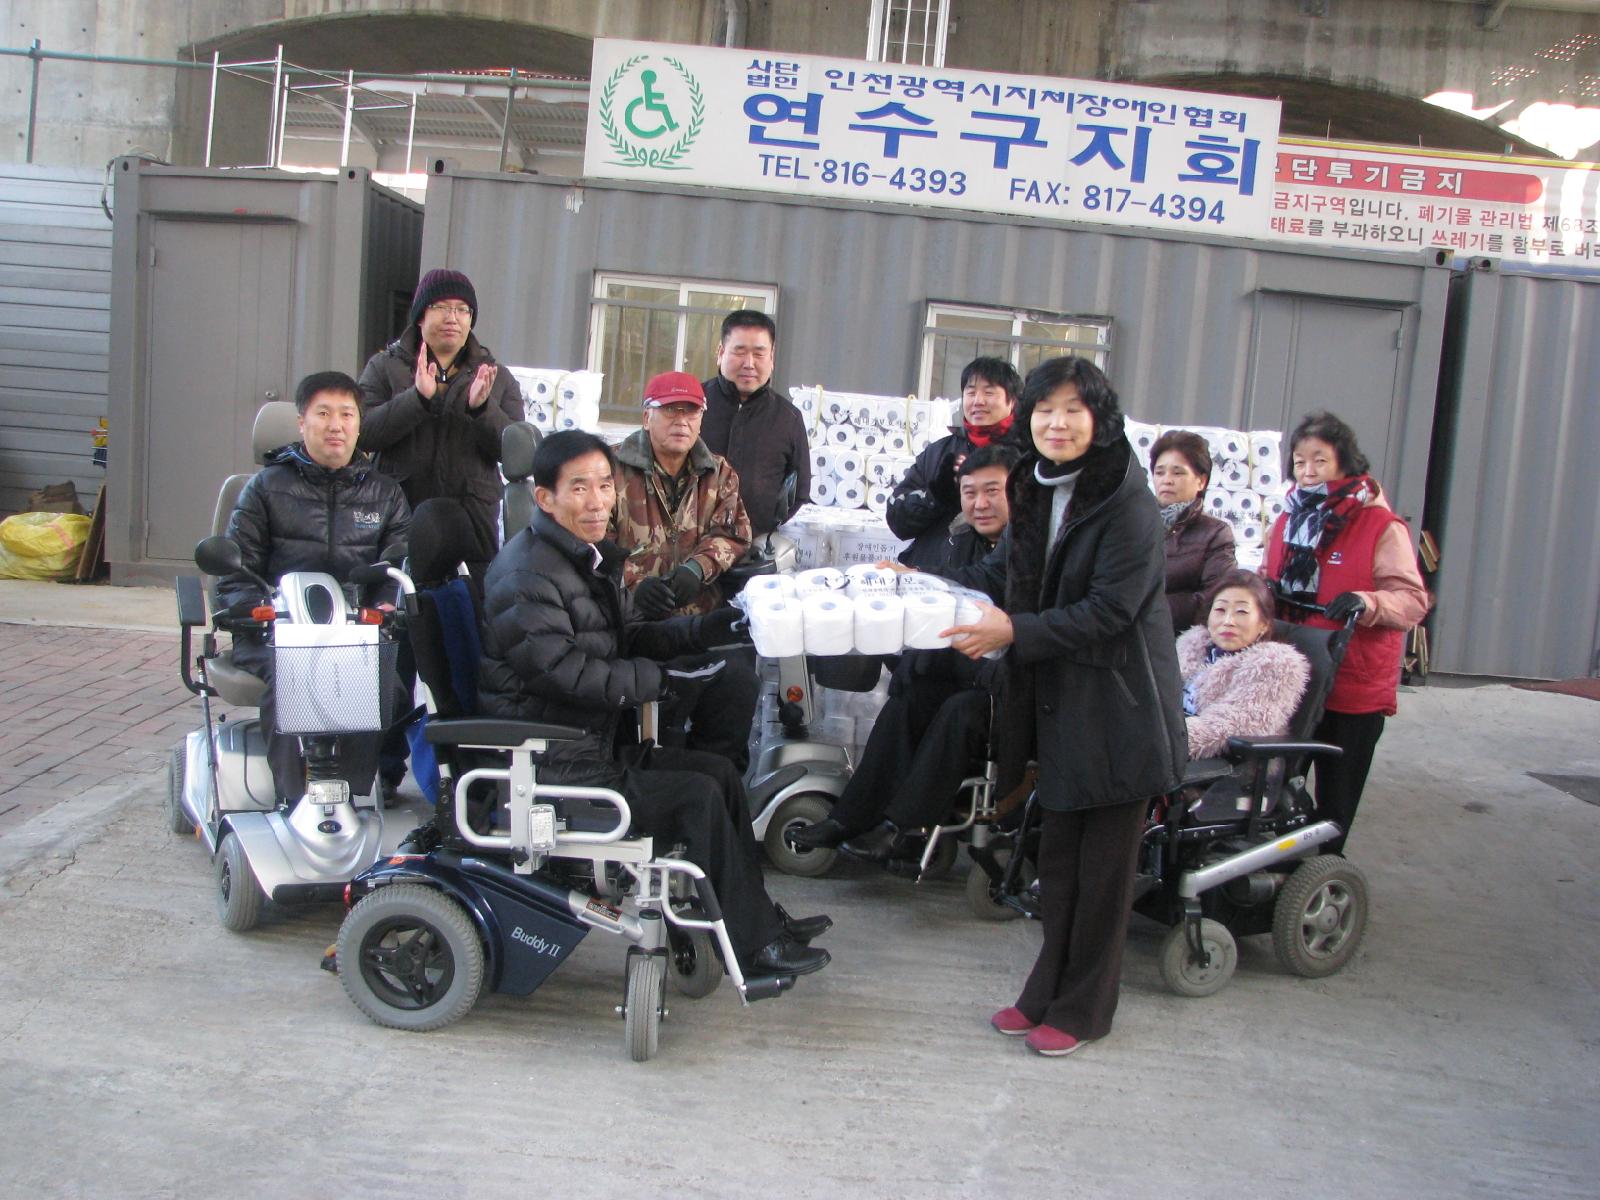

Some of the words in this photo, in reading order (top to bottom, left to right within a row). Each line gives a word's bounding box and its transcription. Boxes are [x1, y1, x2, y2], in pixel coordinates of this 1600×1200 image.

[747, 59, 800, 76] 사단
[747, 74, 798, 90] 법인
[743, 92, 1261, 196] 연수구지회
[1274, 158, 1463, 195] 단투기금지
[1418, 205, 1472, 227] 폐기물
[1480, 210, 1533, 231] 관리법
[1271, 216, 1325, 237] 태료를
[1332, 221, 1423, 246] 부과하오니
[1431, 229, 1504, 253] 쓰레기를
[1513, 236, 1566, 257] 함부로
[511, 926, 549, 954] Buddy
